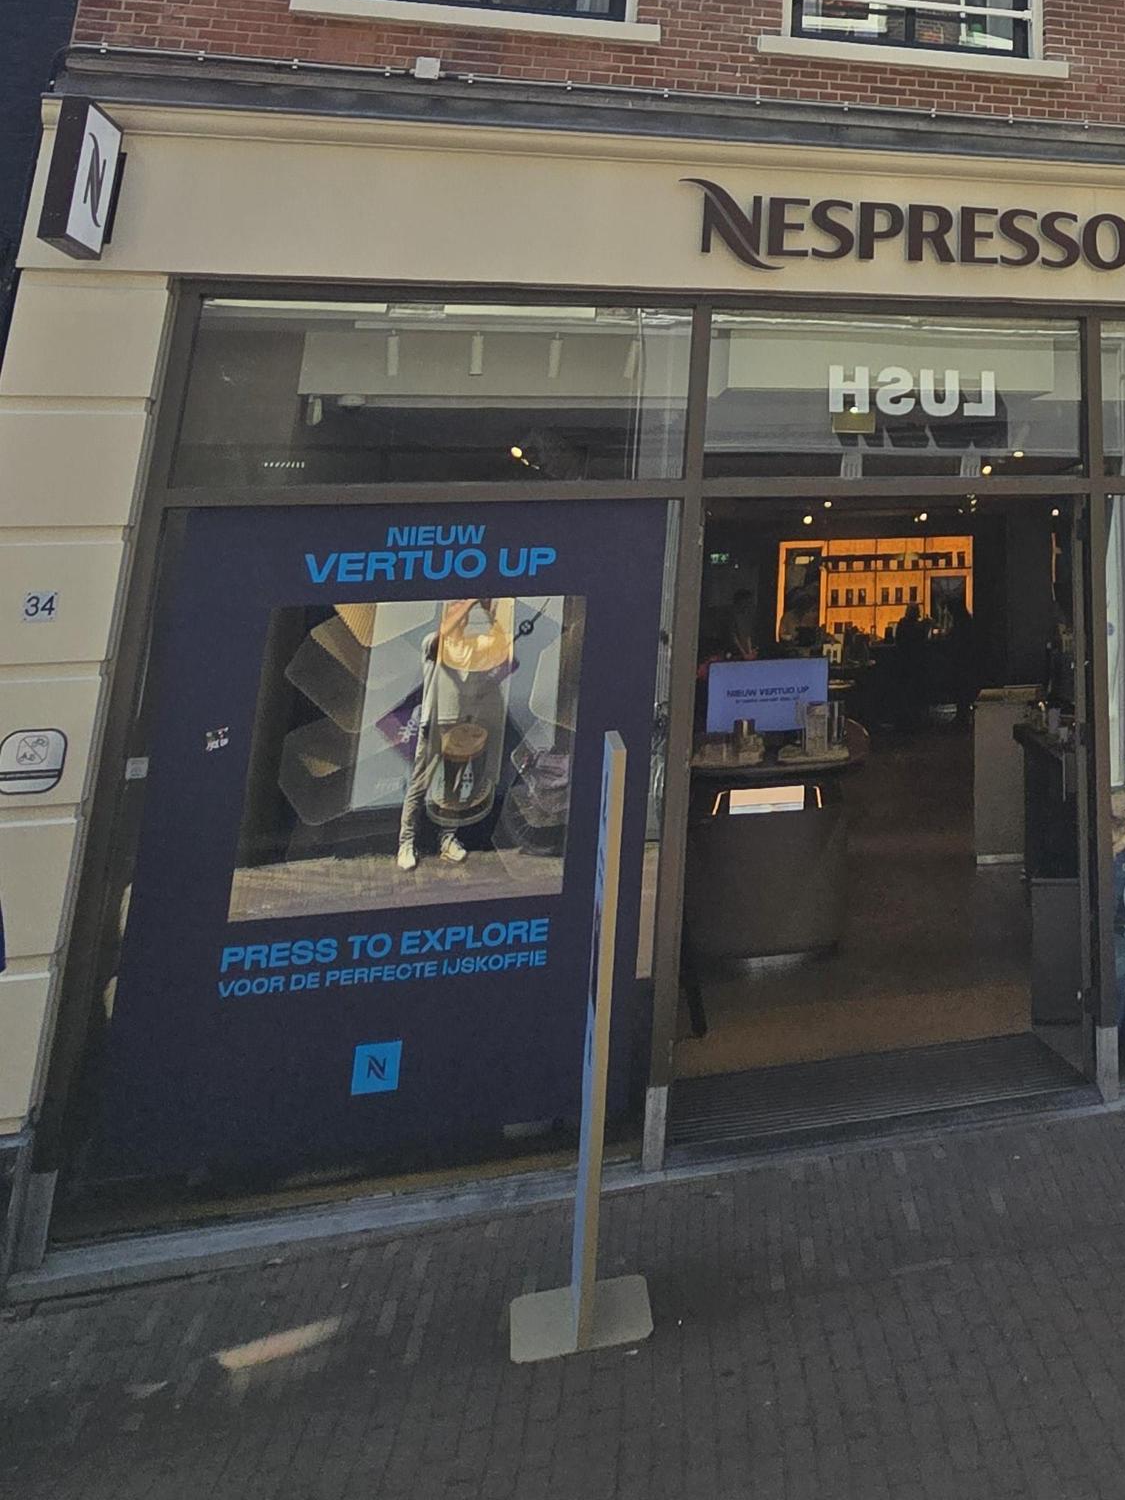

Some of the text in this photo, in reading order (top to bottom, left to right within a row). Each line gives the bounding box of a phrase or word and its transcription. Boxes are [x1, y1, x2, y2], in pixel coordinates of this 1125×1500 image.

[386, 525, 486, 547] NIEUW
[305, 547, 557, 583] VERTUO UP
[24, 595, 56, 618] 34
[726, 688, 757, 698] NIEUW
[760, 686, 795, 696] VERTUO
[219, 918, 550, 973] PRESS TO EXPLORE
[218, 949, 547, 999] VOOR DE PERFECTE IJSKOFFIE
[366, 1053, 390, 1082] N
